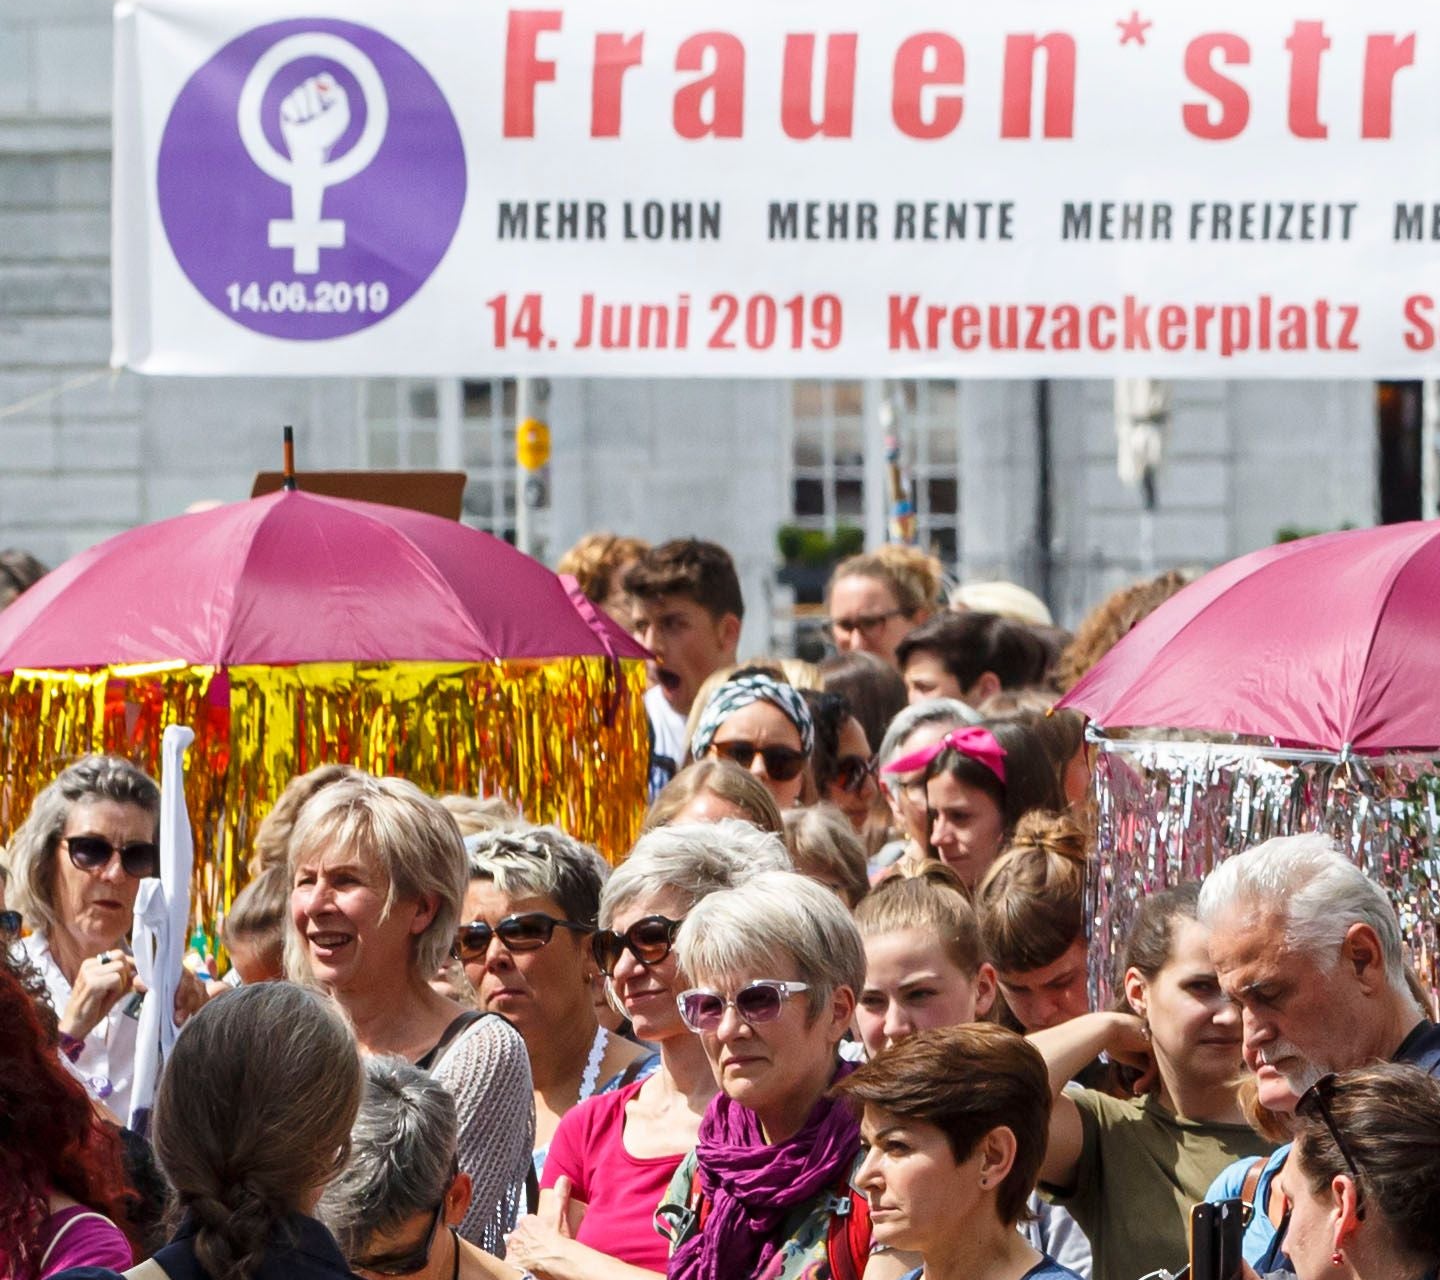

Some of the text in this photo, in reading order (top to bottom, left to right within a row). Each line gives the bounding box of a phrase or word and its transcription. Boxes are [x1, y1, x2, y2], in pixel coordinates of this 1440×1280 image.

[498, 201, 607, 240] MEHR
[623, 201, 721, 240] LOHN
[768, 202, 878, 240] MEHR
[894, 202, 1014, 240] RENTE
[1062, 203, 1172, 240] MEHR
[1190, 203, 1357, 241] FREIZEIT
[227, 283, 389, 314] 14.06.2019
[488, 294, 557, 349] 14.
[575, 294, 689, 349] Juni
[708, 294, 843, 350] 2019
[888, 295, 1360, 357] Kreuzackerplatz
